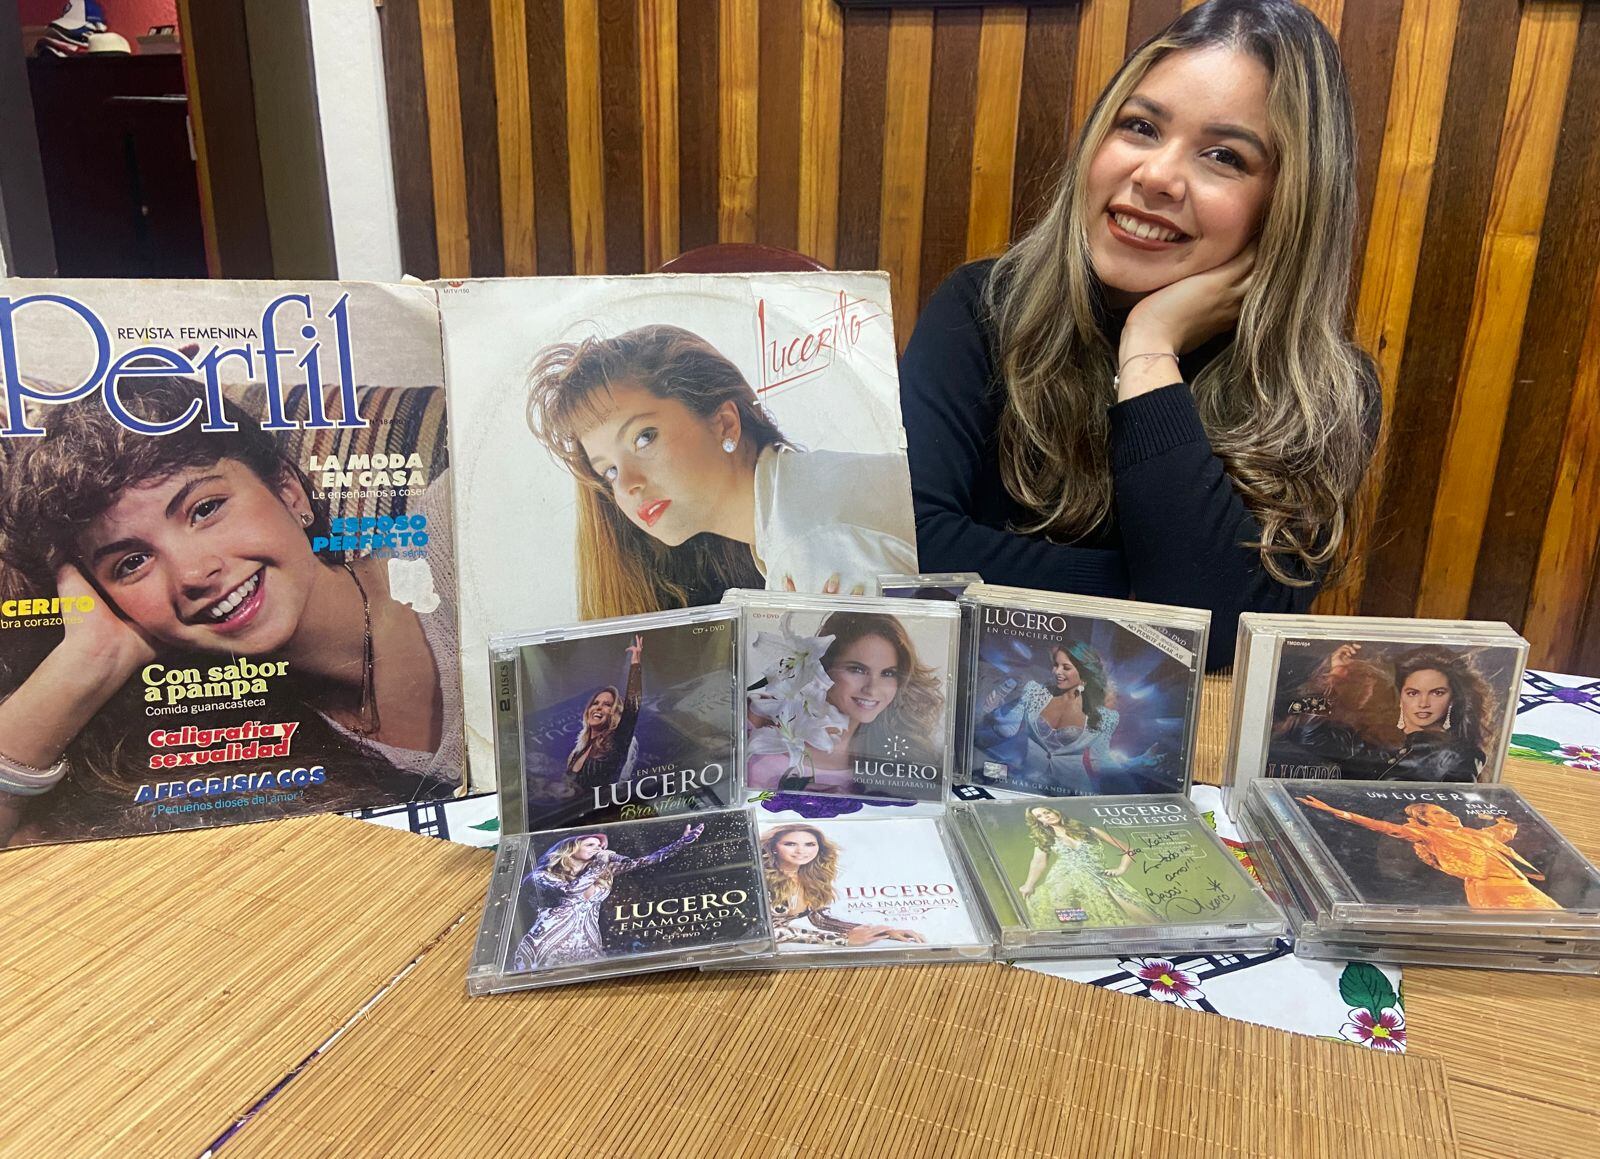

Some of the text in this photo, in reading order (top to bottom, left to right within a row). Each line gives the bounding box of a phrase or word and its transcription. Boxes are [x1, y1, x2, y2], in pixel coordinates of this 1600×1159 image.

[117, 326, 258, 340] REVISTA FEMENINA
[757, 290, 881, 397] Lucerito
[0, 291, 371, 437] Perfil
[310, 453, 423, 471] LA MODA
[321, 470, 425, 487] EN CASA
[312, 491, 325, 500] Le
[328, 489, 388, 500] enseñamos
[399, 487, 426, 497] coser
[332, 514, 427, 533] ESPOSO
[313, 530, 429, 552] PERFECTO
[692, 627, 704, 635] CD
[709, 624, 725, 632] DVD
[985, 608, 1067, 633] LUCERO
[1003, 629, 1063, 641] CONCIERTO
[1171, 634, 1187, 646] DVD
[1157, 640, 1173, 654] AMAR
[142, 657, 289, 686] Con sabor
[144, 678, 268, 704] a pampa
[500, 665, 511, 712] 2 DISCS
[145, 699, 266, 717] Comida guanacasteca
[148, 720, 299, 748] Caligrafía y
[149, 738, 291, 769] sexualidad
[893, 742, 900, 752] L
[854, 760, 938, 780] LUCERO
[134, 765, 326, 804] AFRODISIACOS
[592, 763, 723, 810] LUCERO
[888, 780, 924, 789] FALTABAS
[1031, 782, 1071, 793] GRANDES
[152, 801, 213, 818] ¿Pequeños
[215, 796, 249, 809] dioses
[252, 793, 268, 805] del
[620, 795, 696, 821] Brasileira
[1093, 804, 1182, 817] LUCERO
[1143, 814, 1188, 824] ESTOY
[846, 883, 954, 899] LUCERO
[614, 889, 747, 921] LUCERO
[878, 898, 959, 908] ENAMORADA
[620, 907, 744, 931] ENAMORADA
[643, 921, 722, 937] EN VIVO
[662, 932, 674, 940] CD
